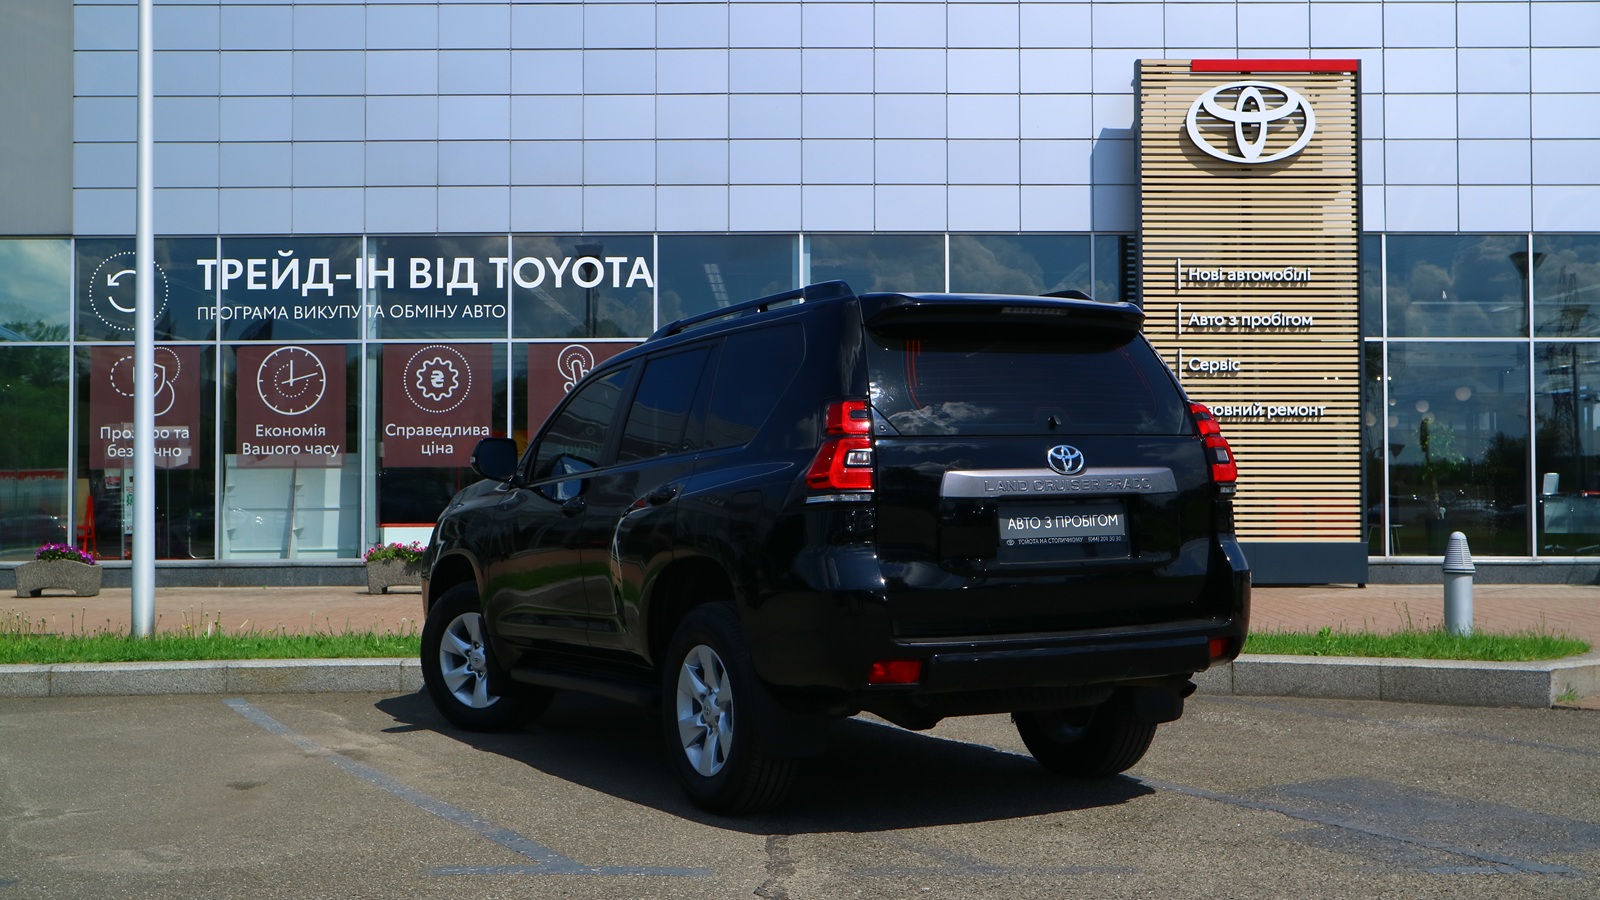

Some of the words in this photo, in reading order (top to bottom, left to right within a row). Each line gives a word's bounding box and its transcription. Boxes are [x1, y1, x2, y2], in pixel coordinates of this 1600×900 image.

[197, 250, 394, 297] ТРЕЙД-ІН
[410, 257, 478, 296] ВІД
[489, 256, 653, 288] TOYOTA
[1188, 267, 1223, 281] Нові
[1227, 266, 1311, 281] автомобілі
[197, 305, 289, 320] ПРОГРАМА
[294, 305, 362, 320] ВИКУПУ
[365, 304, 386, 318] ТА
[389, 304, 458, 319] ОБМІНУ
[461, 304, 506, 318] АВТО
[1188, 313, 1224, 326] Авто
[1228, 315, 1236, 326] з
[1241, 312, 1313, 329] пробігом
[1188, 357, 1241, 374] Сервіс
[1207, 402, 1263, 416] зовний
[1267, 404, 1326, 419] ремонт
[100, 426, 170, 443] Проо
[173, 429, 190, 439] та
[255, 424, 326, 437] Економія
[385, 424, 490, 439] Справедлива
[107, 444, 182, 458] безчно
[242, 442, 302, 456] Вашого
[305, 444, 340, 458] часу
[421, 442, 454, 455] ціна
[984, 480, 1029, 493] LAND
[1033, 479, 1101, 492] CRUISER
[1104, 477, 1152, 491] PRADO
[1008, 516, 1041, 530] АВТО
[1055, 514, 1119, 528] ПРОБІГОМ
